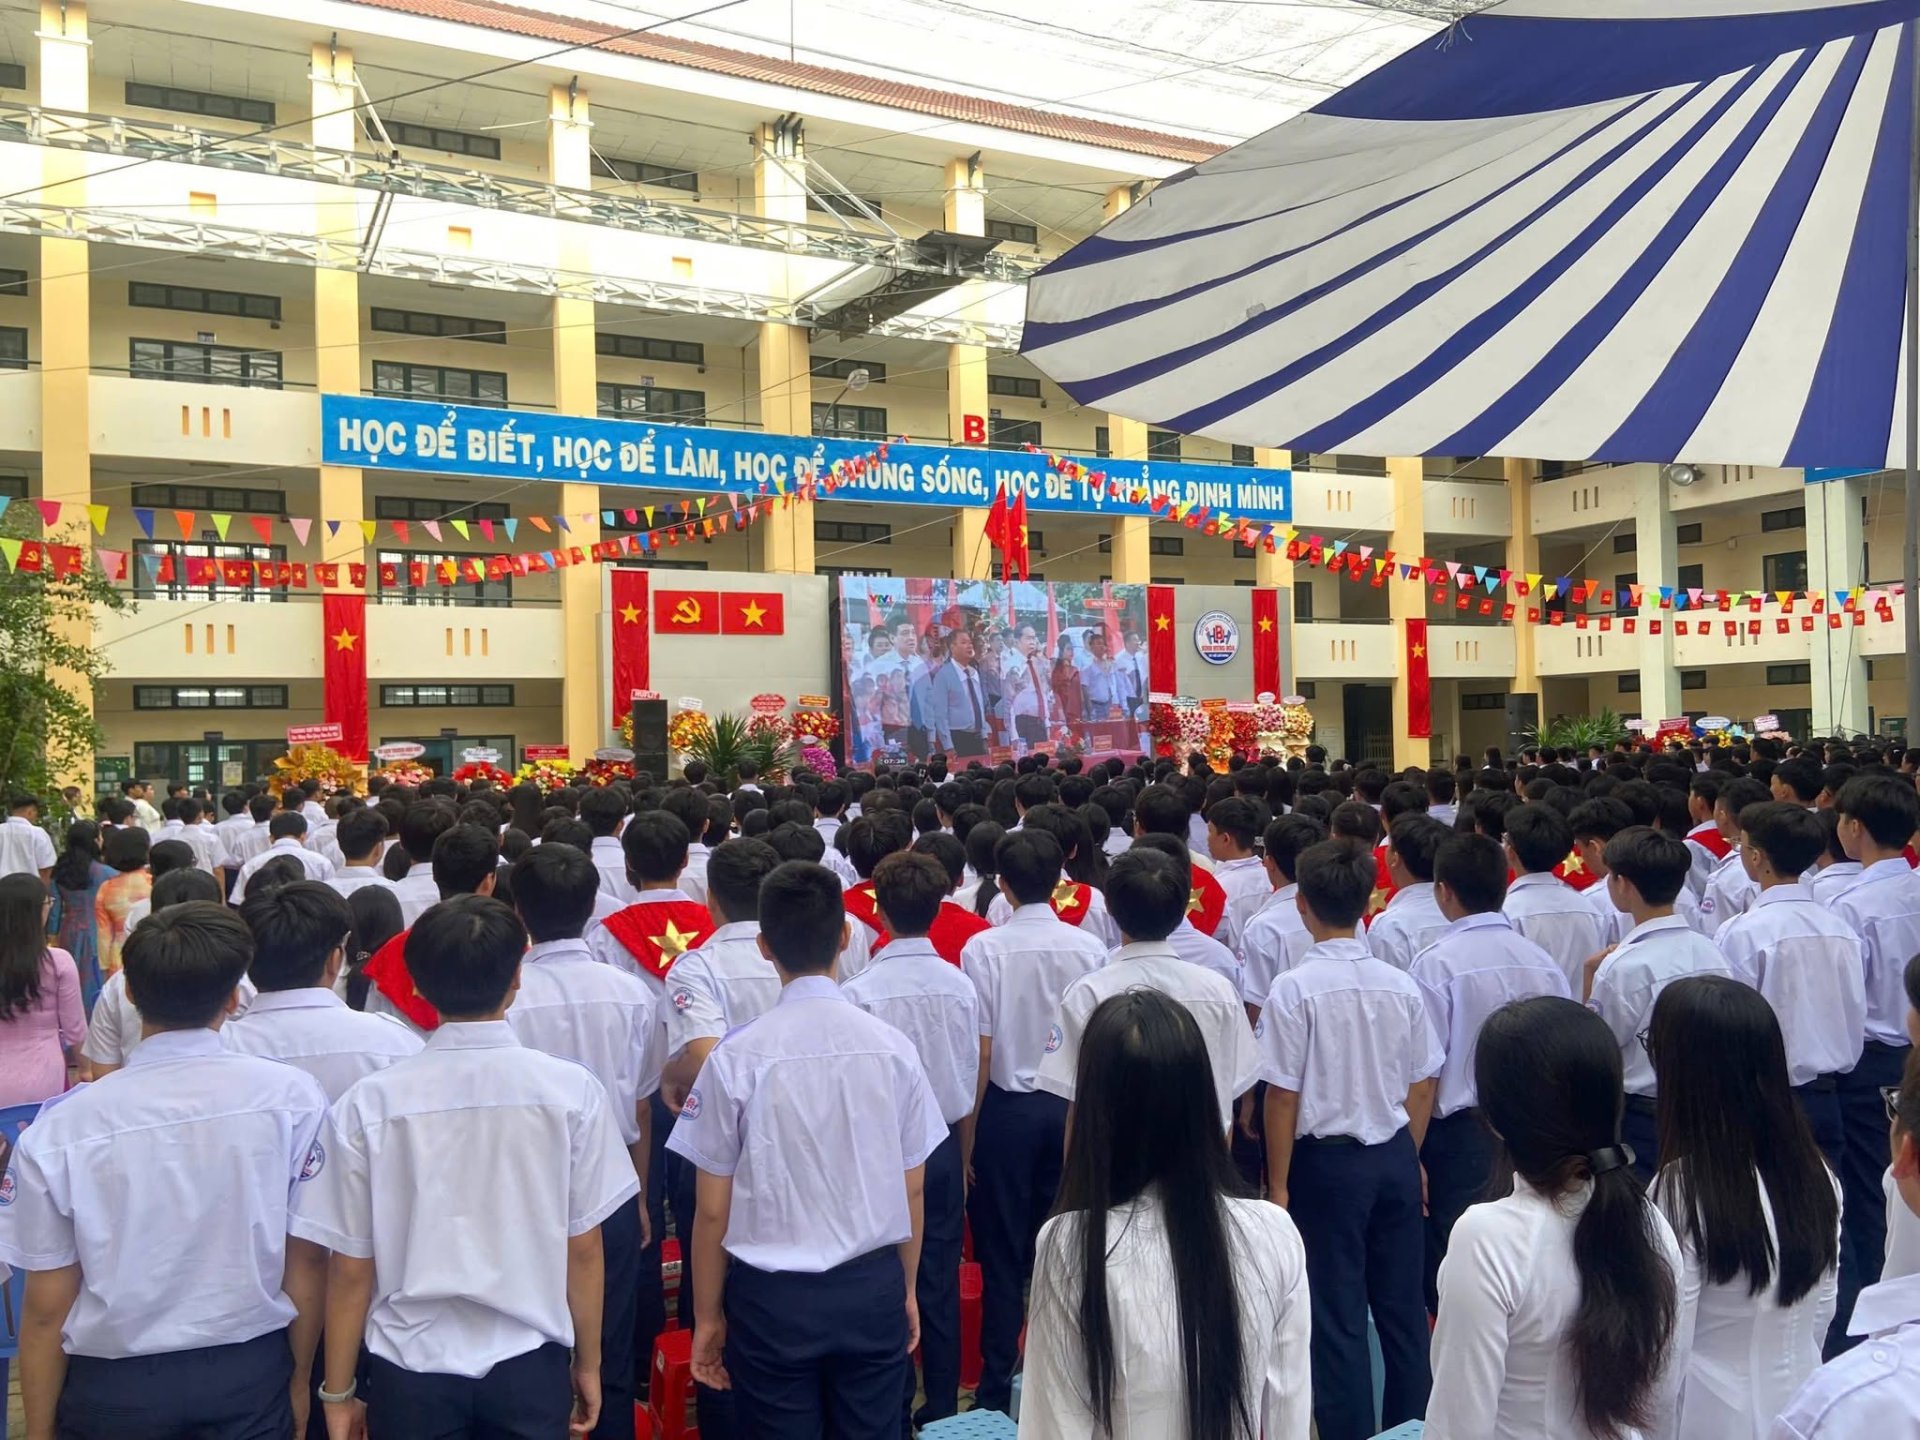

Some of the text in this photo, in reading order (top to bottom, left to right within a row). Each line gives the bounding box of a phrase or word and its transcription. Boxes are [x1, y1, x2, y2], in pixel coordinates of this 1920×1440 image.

[339, 418, 407, 463] HỌC
[415, 410, 457, 460] ĐỂ
[468, 418, 544, 472] BIẾT,
[552, 436, 612, 478] HỌC
[619, 428, 657, 475] ĐỂ
[665, 438, 726, 485] LÀM,
[734, 451, 787, 491] HỌC
[921, 455, 989, 501] SỐNG,
[1238, 478, 1284, 510] MÌNH
[963, 414, 986, 444] B
